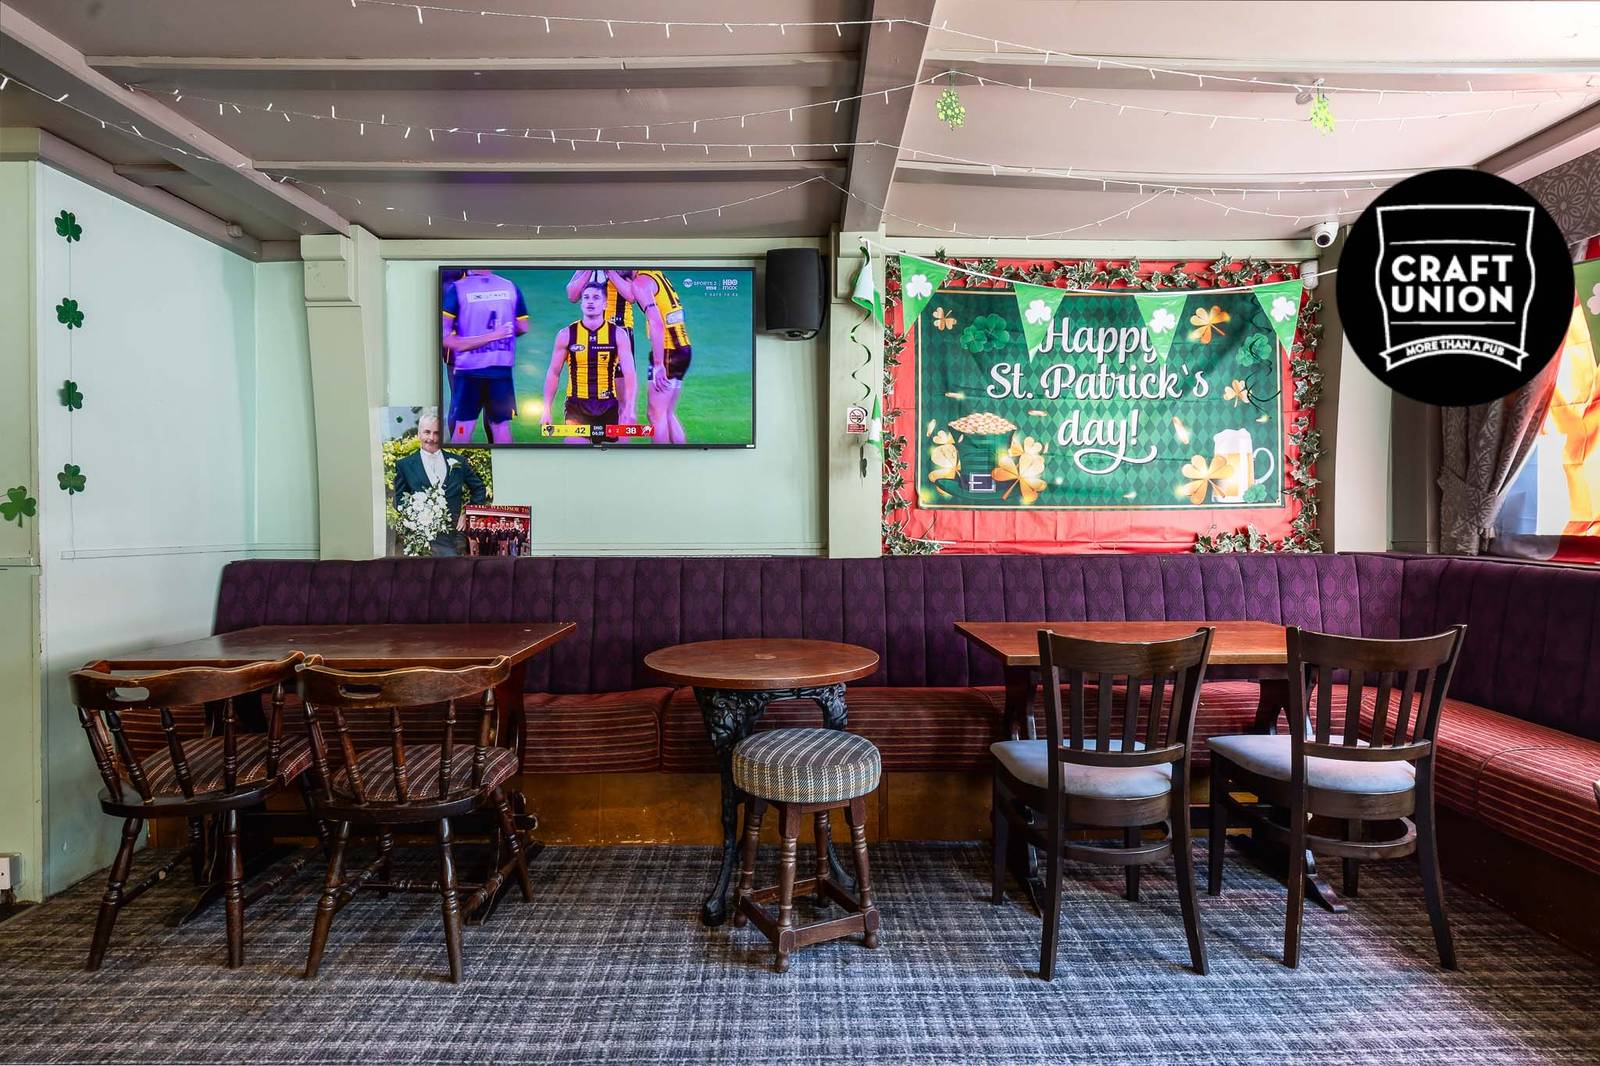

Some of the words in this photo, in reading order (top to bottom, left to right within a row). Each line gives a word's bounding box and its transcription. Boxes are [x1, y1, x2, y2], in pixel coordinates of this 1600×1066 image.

[722, 278, 738, 286] HBO
[1038, 316, 1158, 364] Happy
[986, 362, 1034, 400] St.
[574, 427, 586, 435] 42
[625, 426, 637, 435] 38
[1057, 408, 1158, 475] day!
